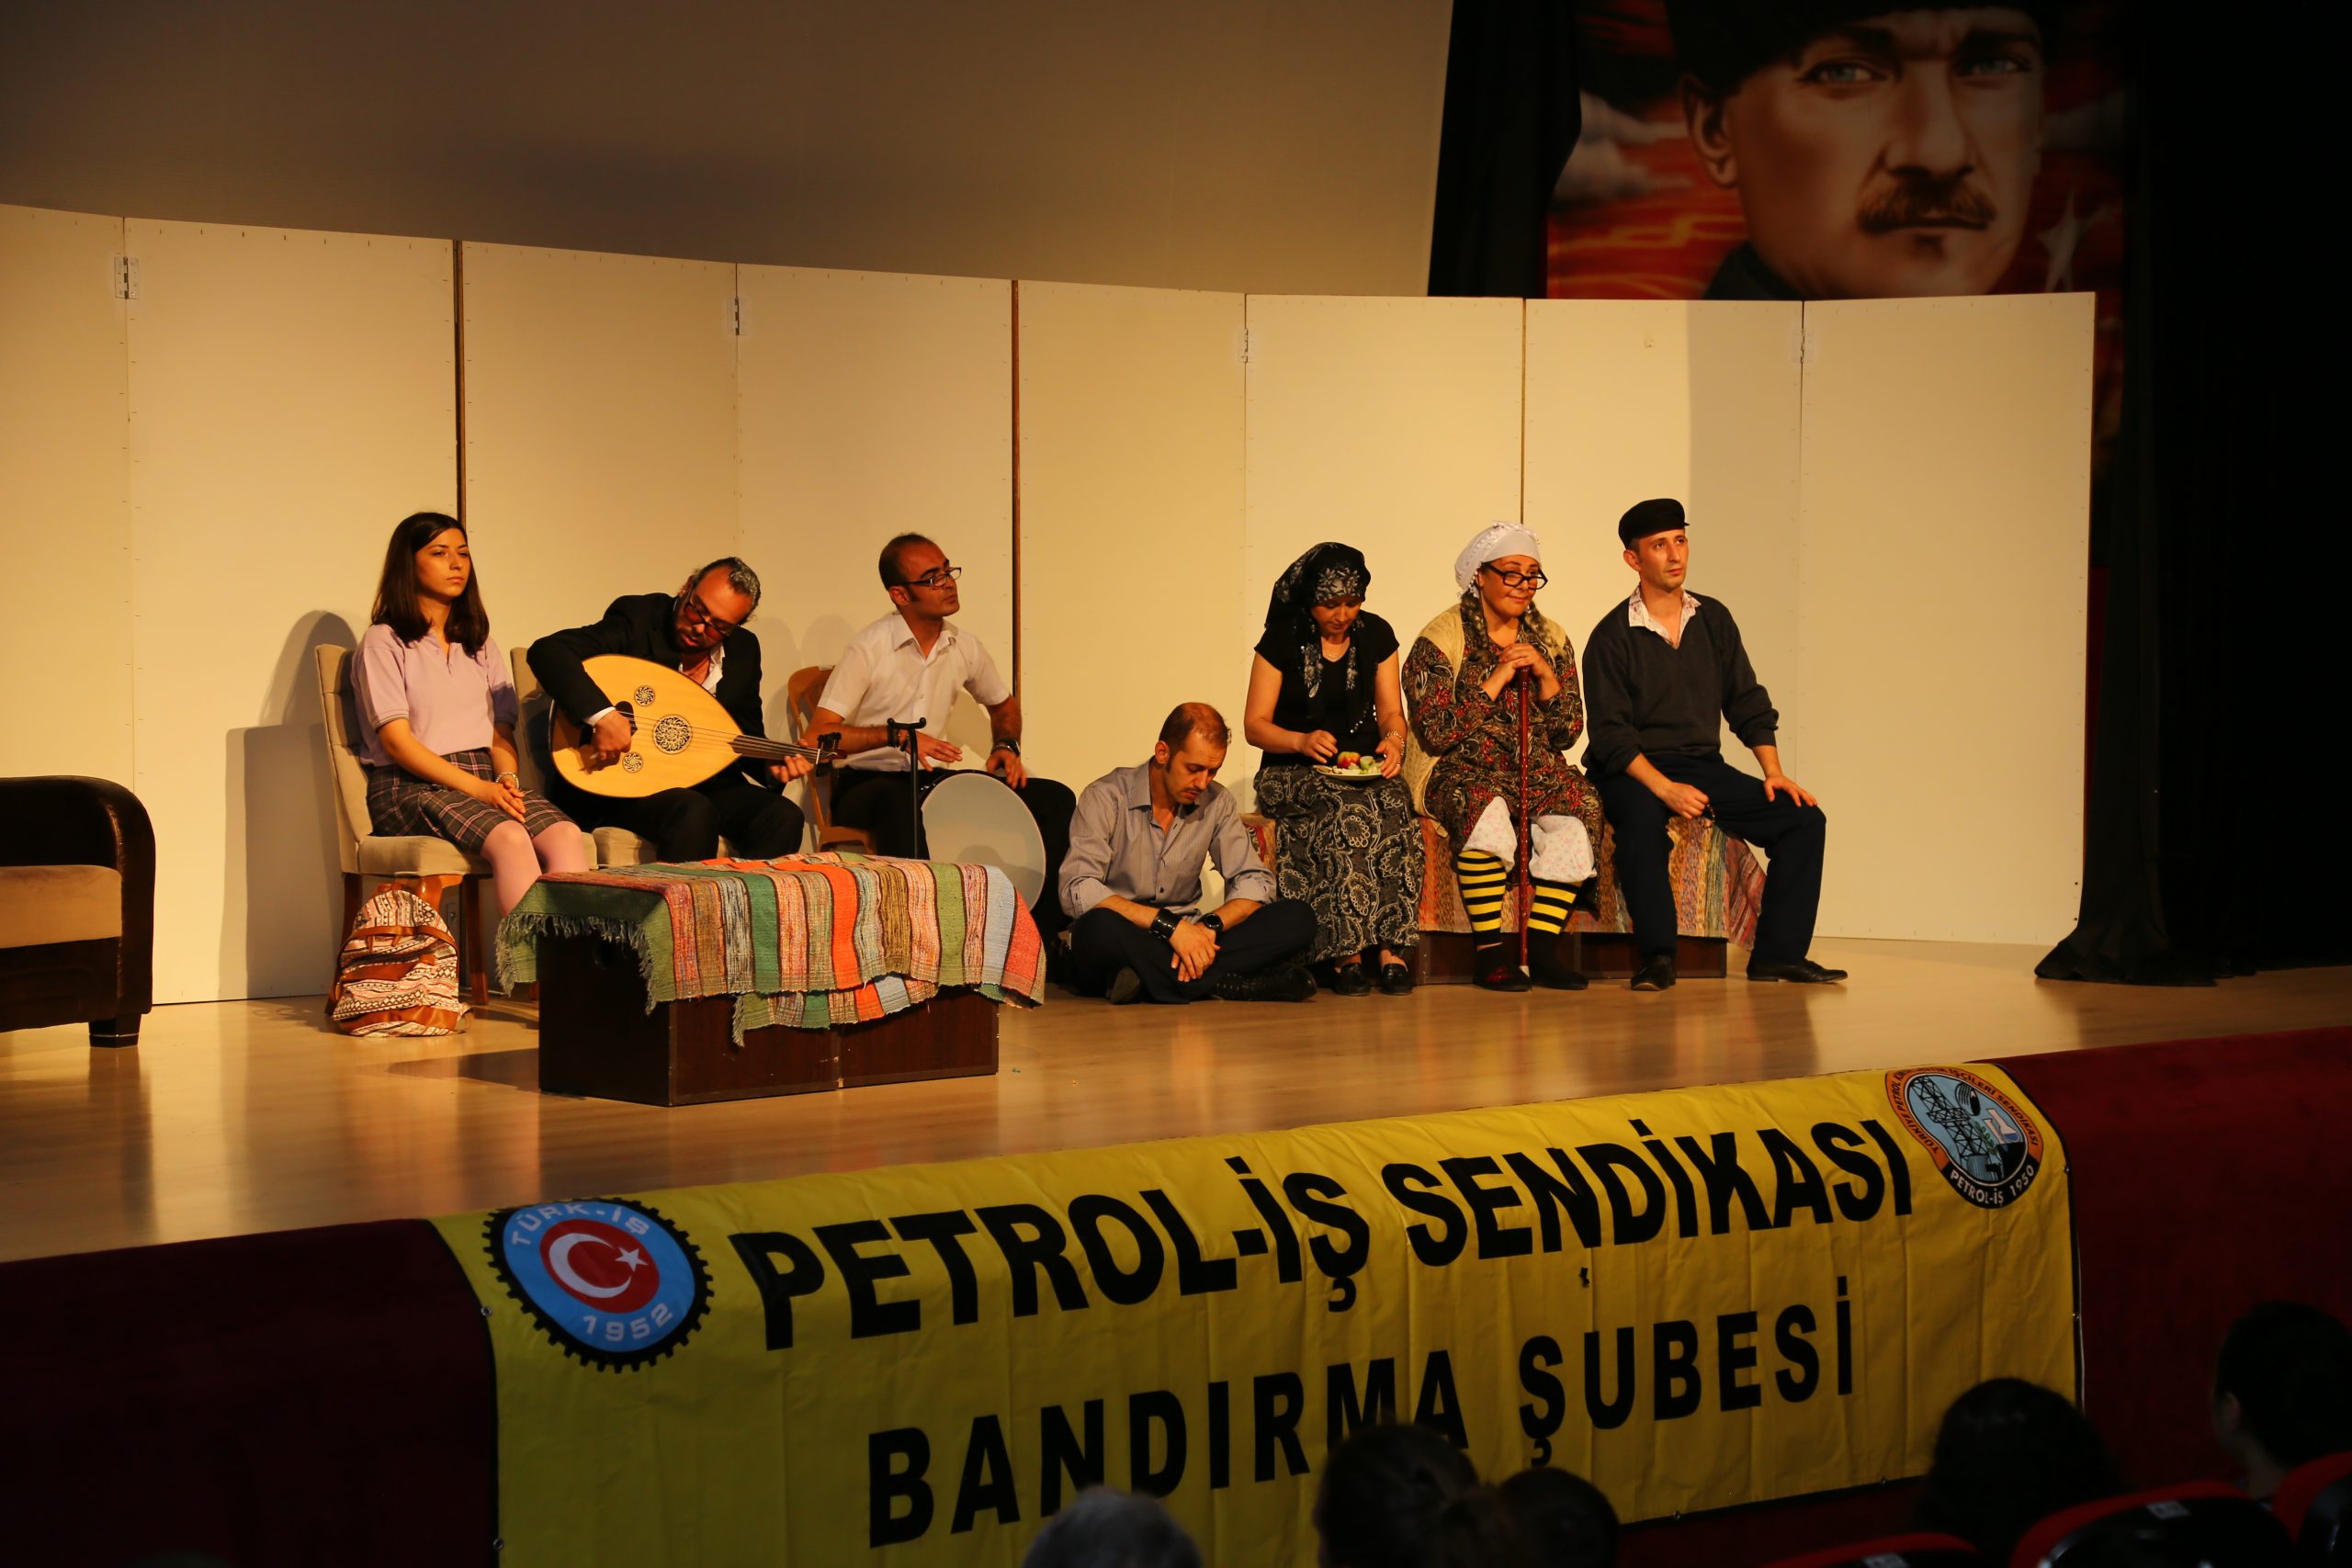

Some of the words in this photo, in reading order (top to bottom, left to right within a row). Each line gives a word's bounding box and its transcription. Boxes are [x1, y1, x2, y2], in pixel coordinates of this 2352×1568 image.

[1950, 1168, 2004, 1207] PETROL-İŞ
[2009, 1164, 2035, 1197] 1950
[511, 1202, 650, 1246] TÜRK-İŞ
[729, 1155, 1370, 1351] PETROL-İŞ
[1382, 1118, 1913, 1268] SENDİKASI
[582, 1302, 674, 1342] 1952
[868, 1349, 1470, 1550] BANDIRMA
[1518, 1275, 1854, 1468] ŞUBESİ
